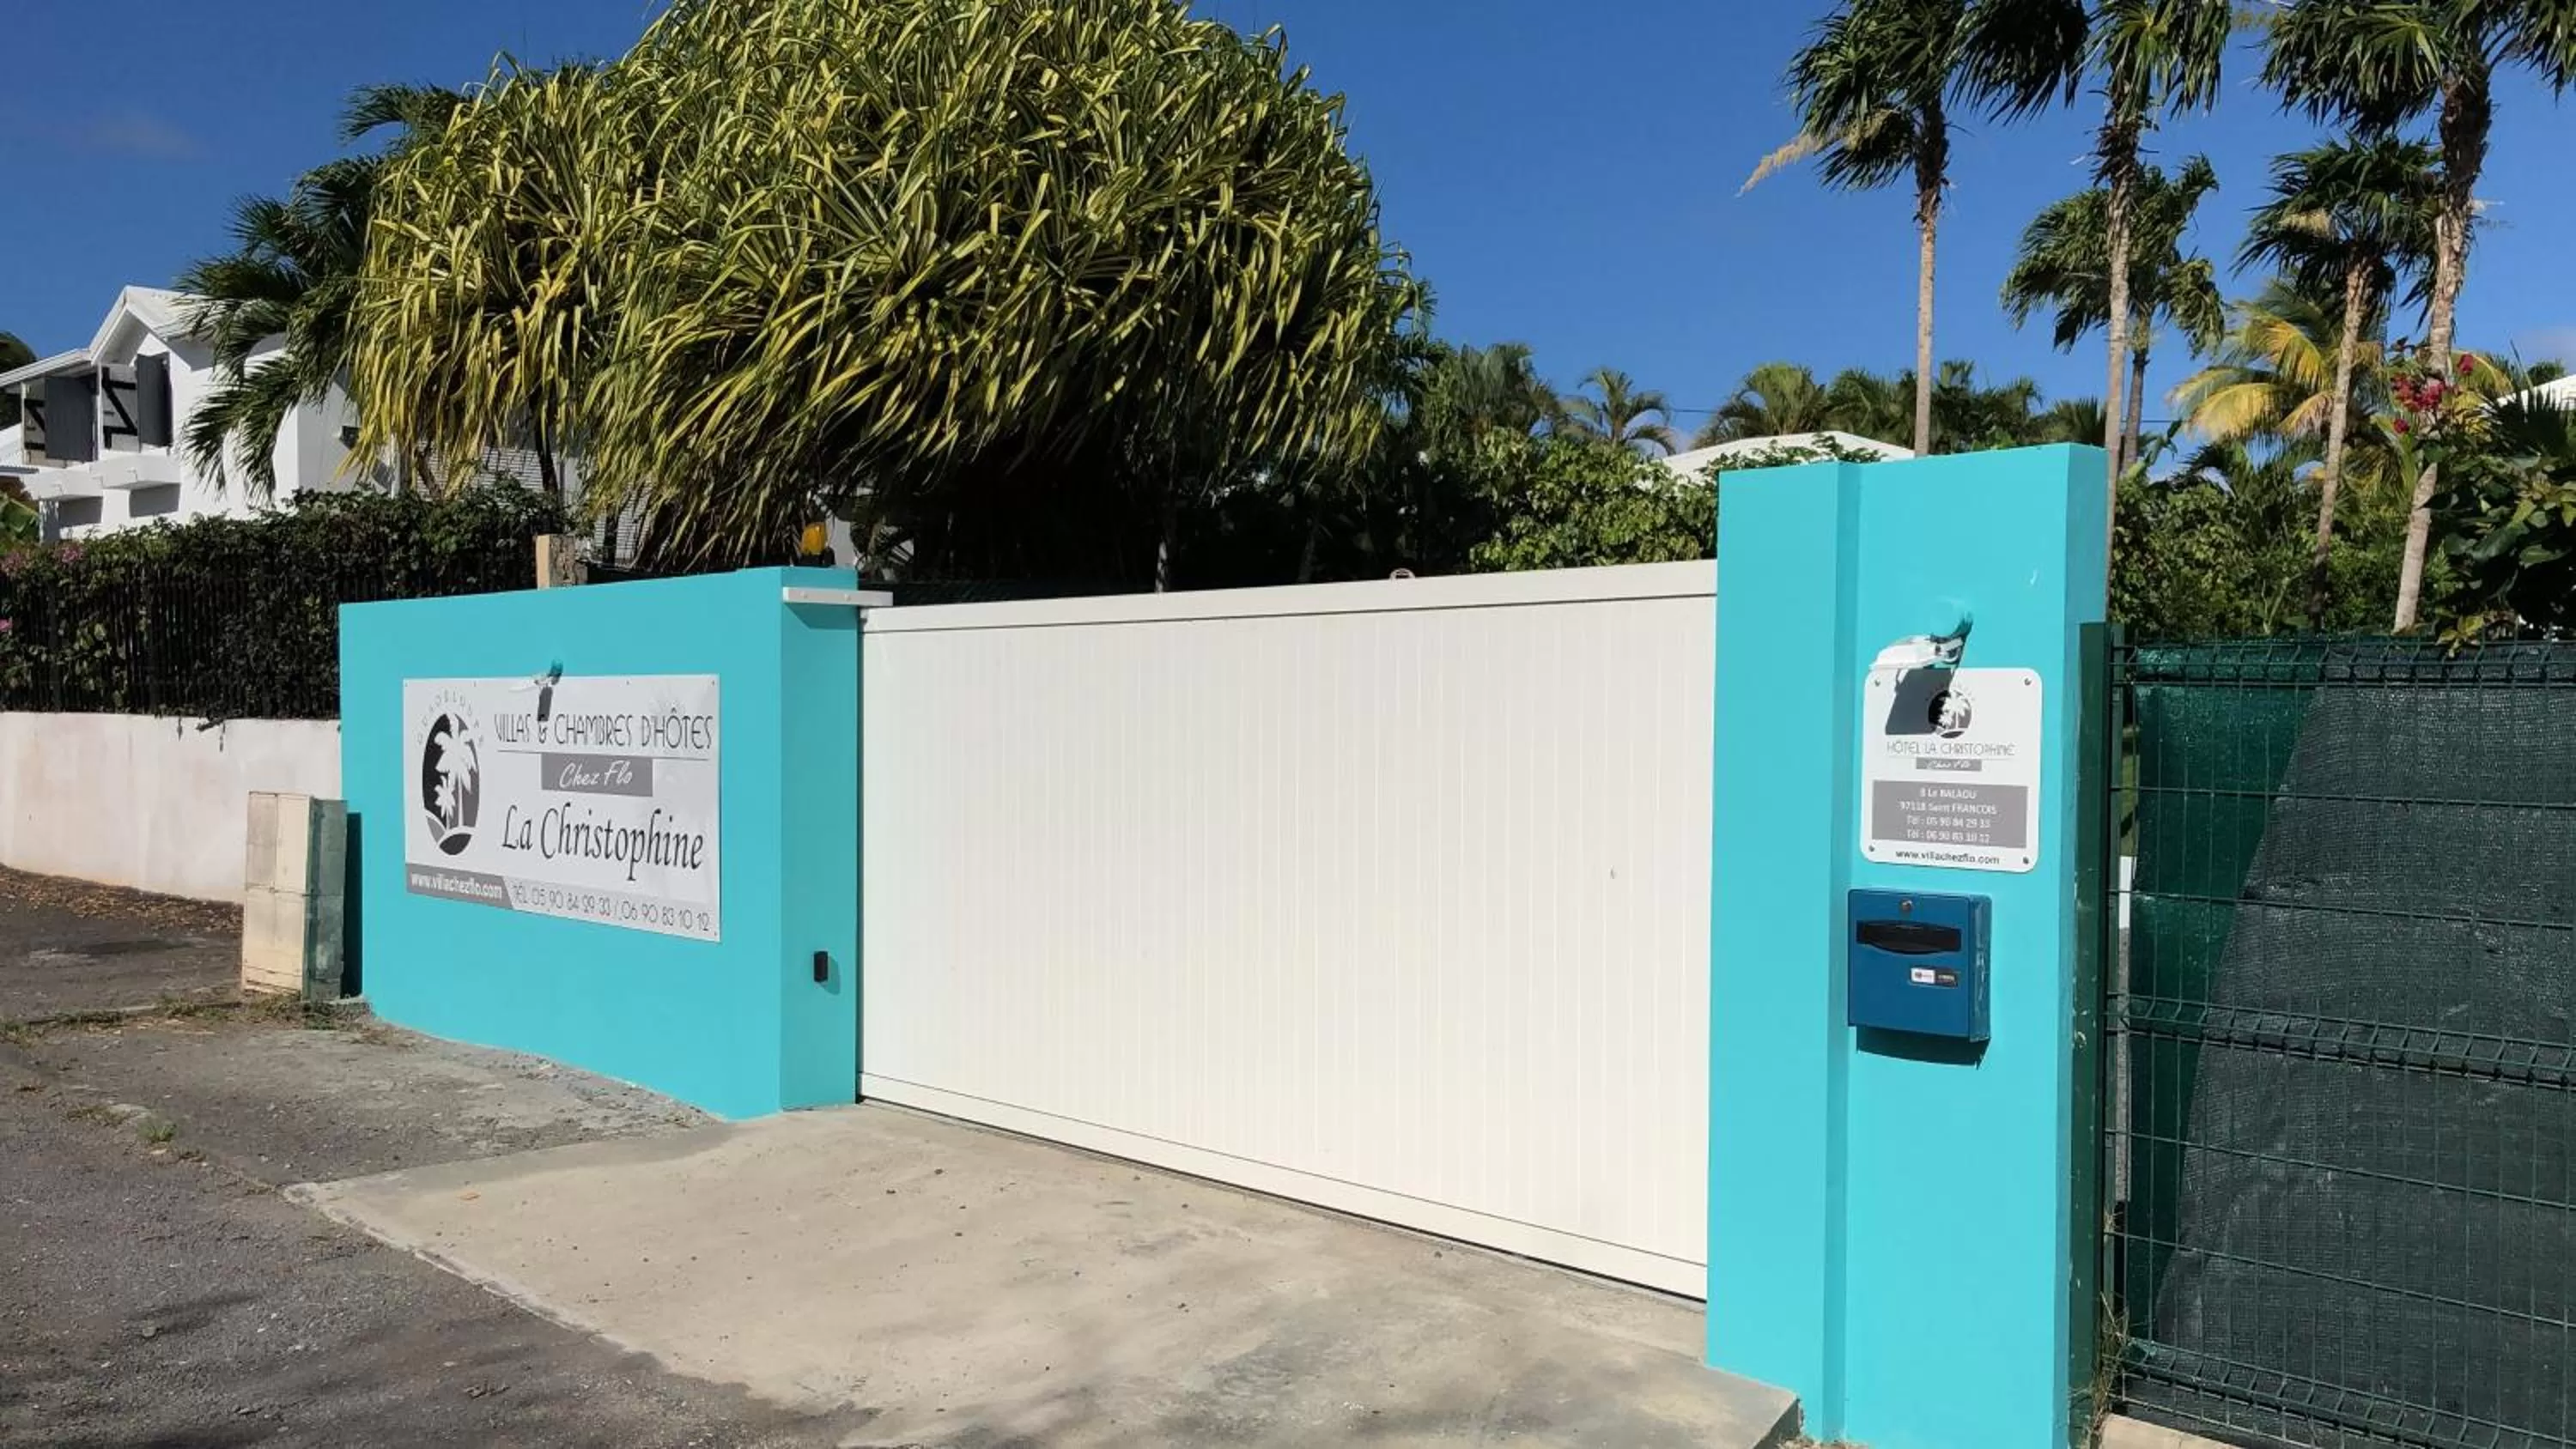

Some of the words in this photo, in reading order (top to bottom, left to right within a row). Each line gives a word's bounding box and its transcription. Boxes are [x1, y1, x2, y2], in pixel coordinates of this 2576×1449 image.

[494, 713, 532, 743] VILLAS
[537, 714, 548, 744] &
[554, 713, 634, 747] CHAMBRES
[641, 706, 714, 749] D'HÔTES
[1886, 739, 1920, 755] HÔTEL
[1924, 741, 1937, 755] LA
[1940, 742, 2016, 756] CHRISTOPHINE
[558, 761, 601, 789] Chez
[603, 759, 634, 786] Flo
[1926, 815, 1938, 826] 05
[1965, 818, 1978, 828] 29
[501, 803, 533, 852] La
[540, 801, 704, 882] Christophine
[1895, 851, 2001, 865] www.villachezflo.com
[410, 872, 503, 900] www.villachezflo.com
[532, 888, 545, 906] 05
[550, 890, 564, 909] 90
[621, 900, 638, 921] 06
[641, 903, 659, 923] 90
[678, 908, 693, 930] 10
[696, 912, 710, 932] 12
